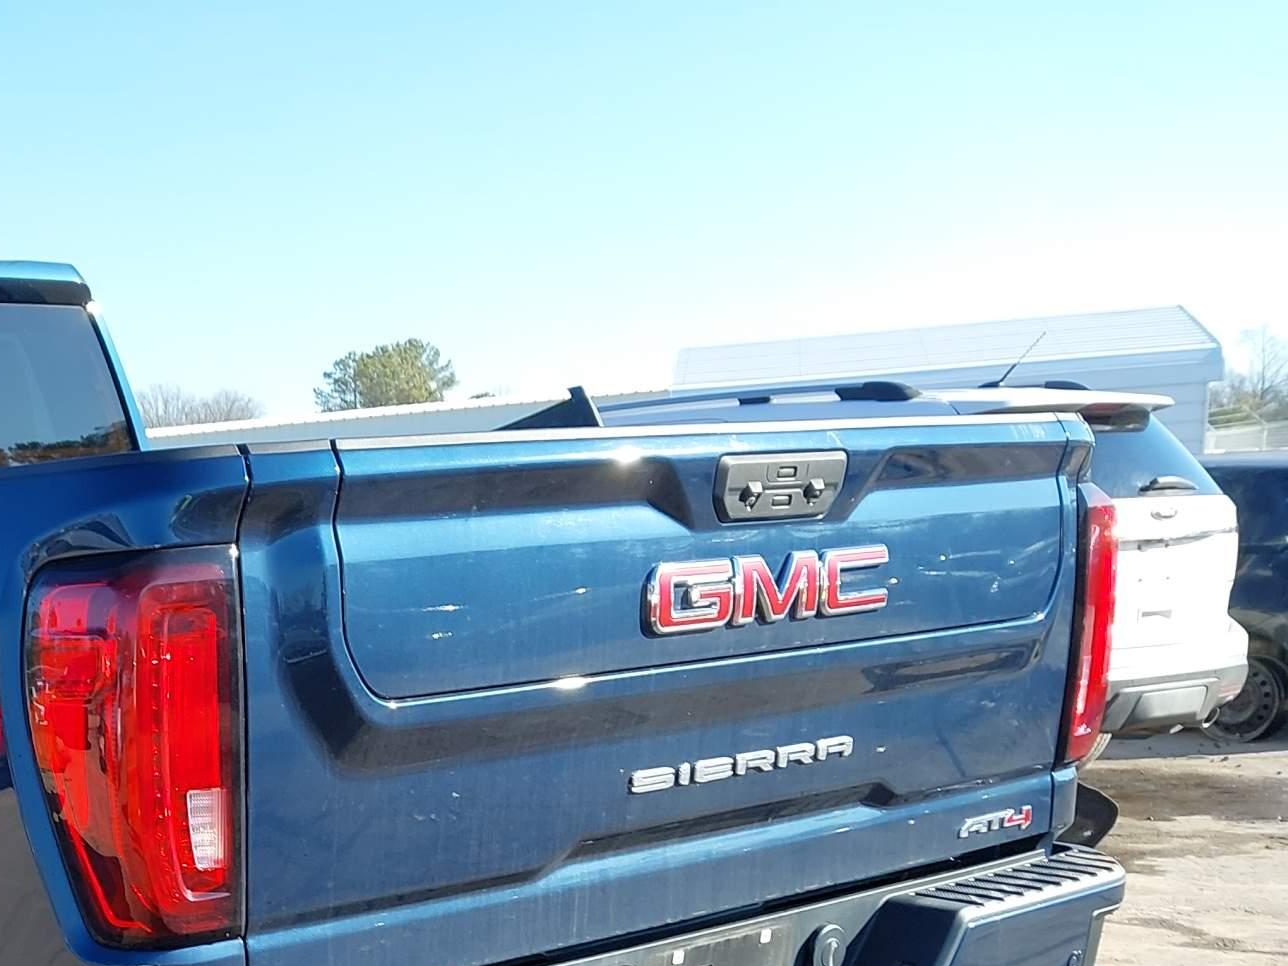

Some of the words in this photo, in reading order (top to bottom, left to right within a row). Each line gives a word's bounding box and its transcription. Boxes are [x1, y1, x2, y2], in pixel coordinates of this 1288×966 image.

[646, 543, 889, 635] GMC
[629, 735, 854, 795] SIERRA
[958, 805, 1033, 839] AT4
